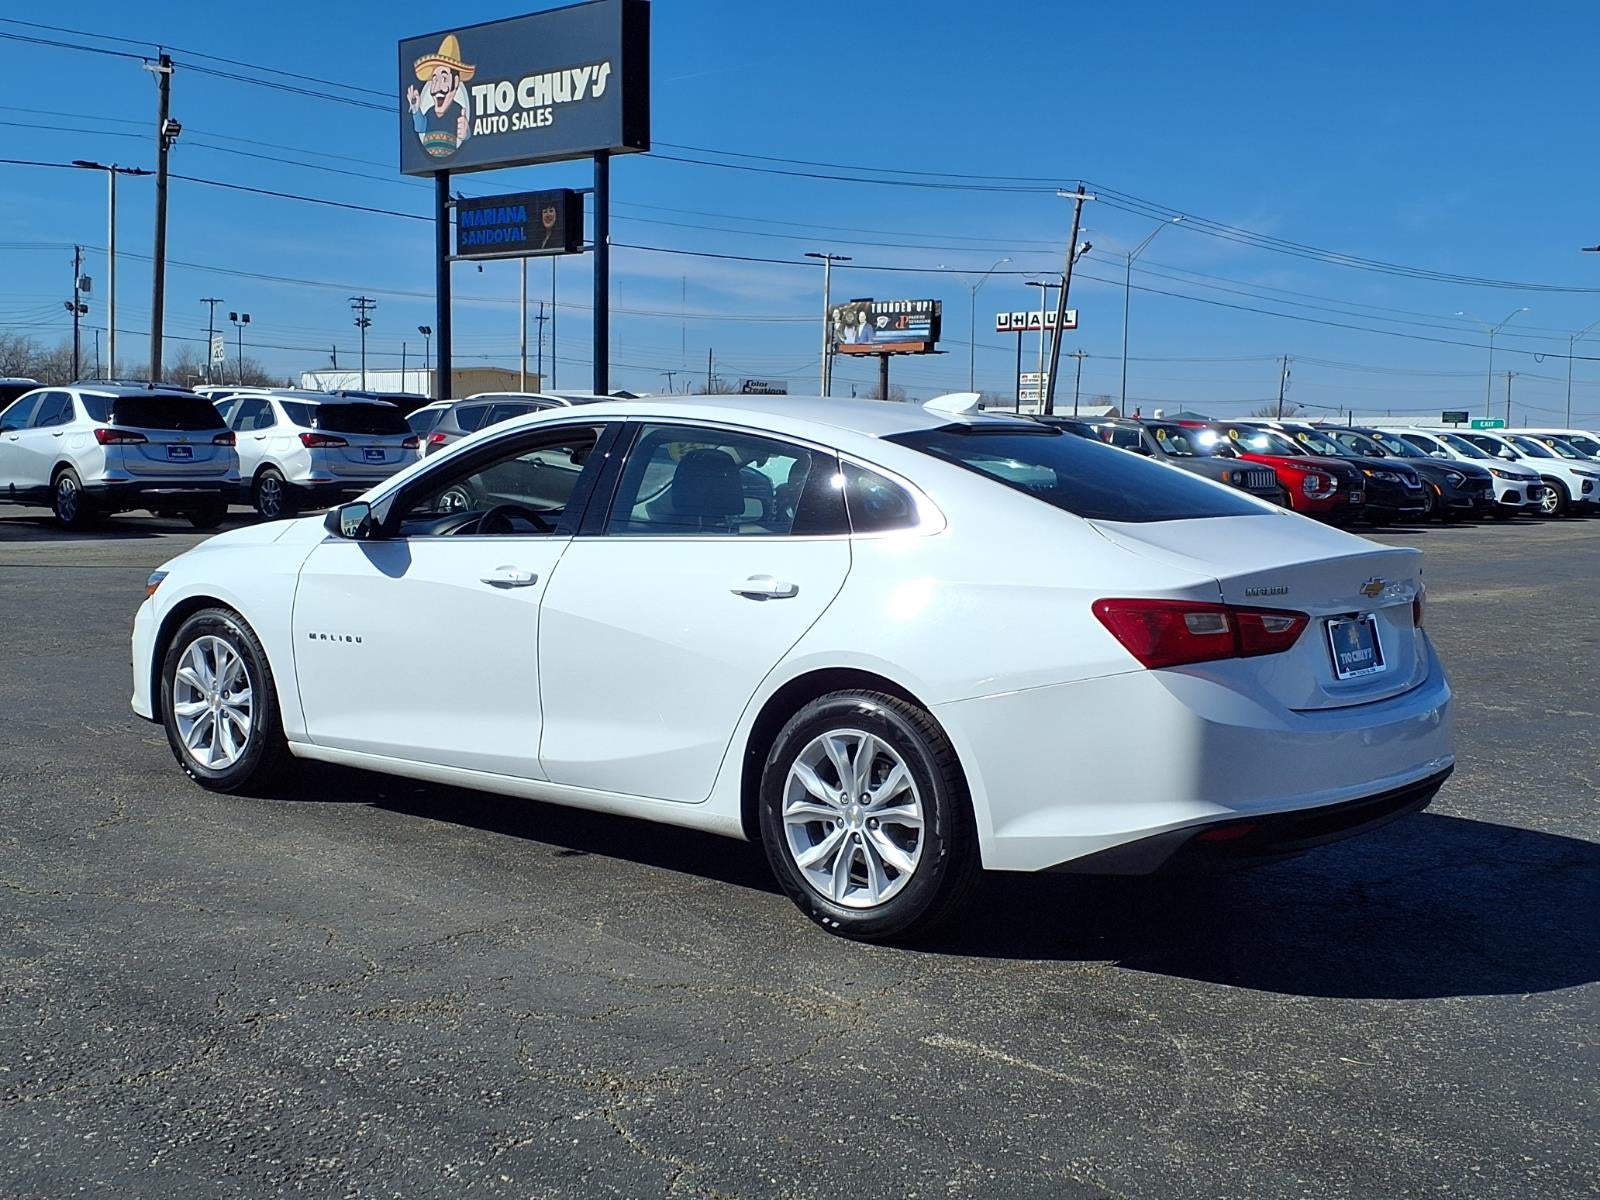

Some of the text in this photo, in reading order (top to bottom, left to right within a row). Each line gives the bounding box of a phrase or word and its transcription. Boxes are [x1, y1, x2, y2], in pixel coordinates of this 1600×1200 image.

[472, 62, 611, 116] TIO CHUY'S
[473, 107, 553, 136] AUTO SALES
[461, 206, 528, 228] MARIANA
[461, 227, 527, 245] SANDOVAL
[871, 301, 933, 314] THUNDER UP!
[309, 633, 362, 643] MALIBU
